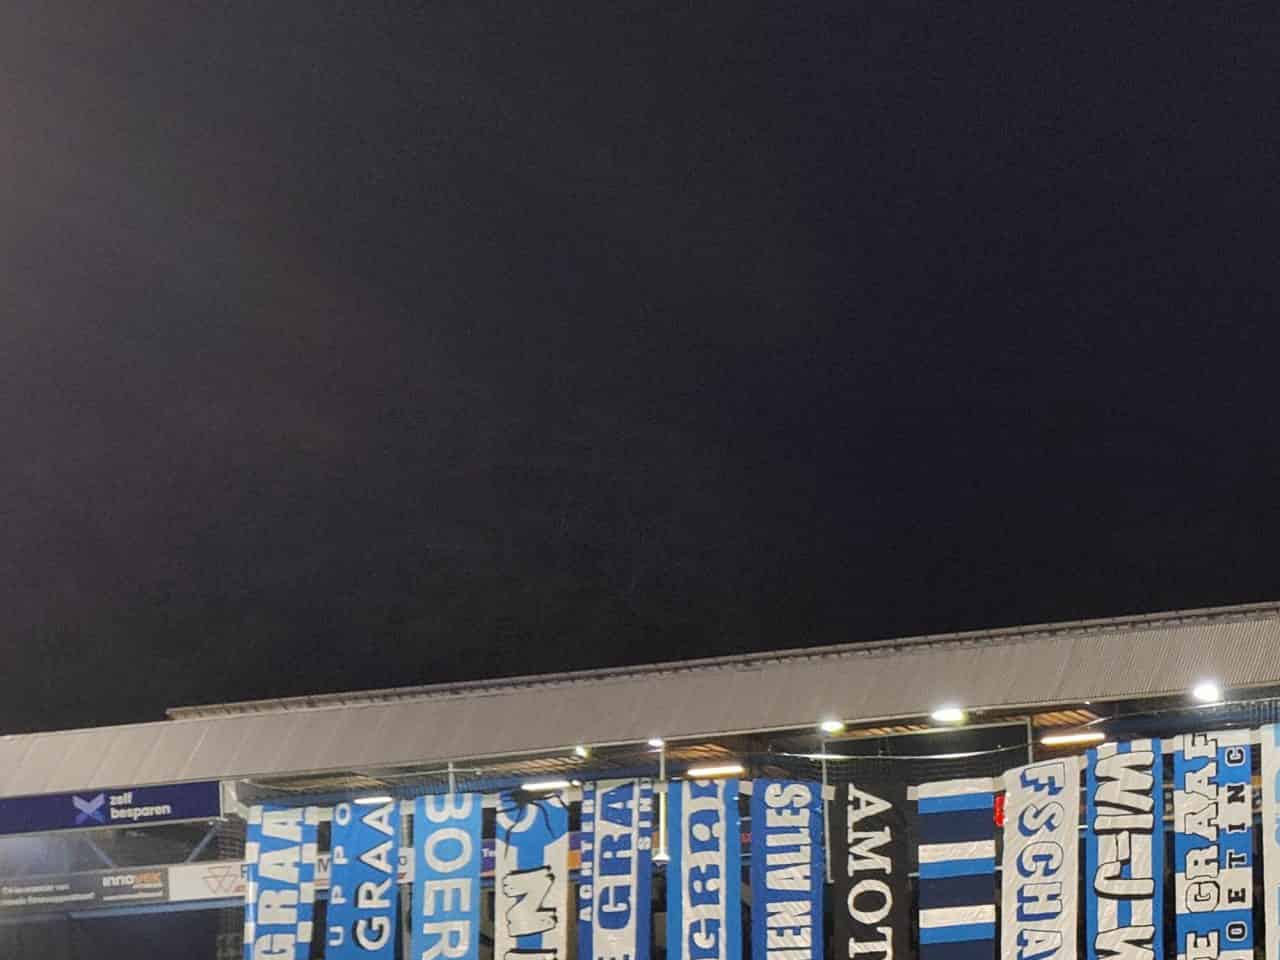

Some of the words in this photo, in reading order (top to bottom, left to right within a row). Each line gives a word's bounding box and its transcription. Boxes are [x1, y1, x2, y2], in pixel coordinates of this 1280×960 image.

[357, 803, 396, 951] GRAA
[597, 783, 634, 930] GRA
[764, 783, 813, 892] ALLES
